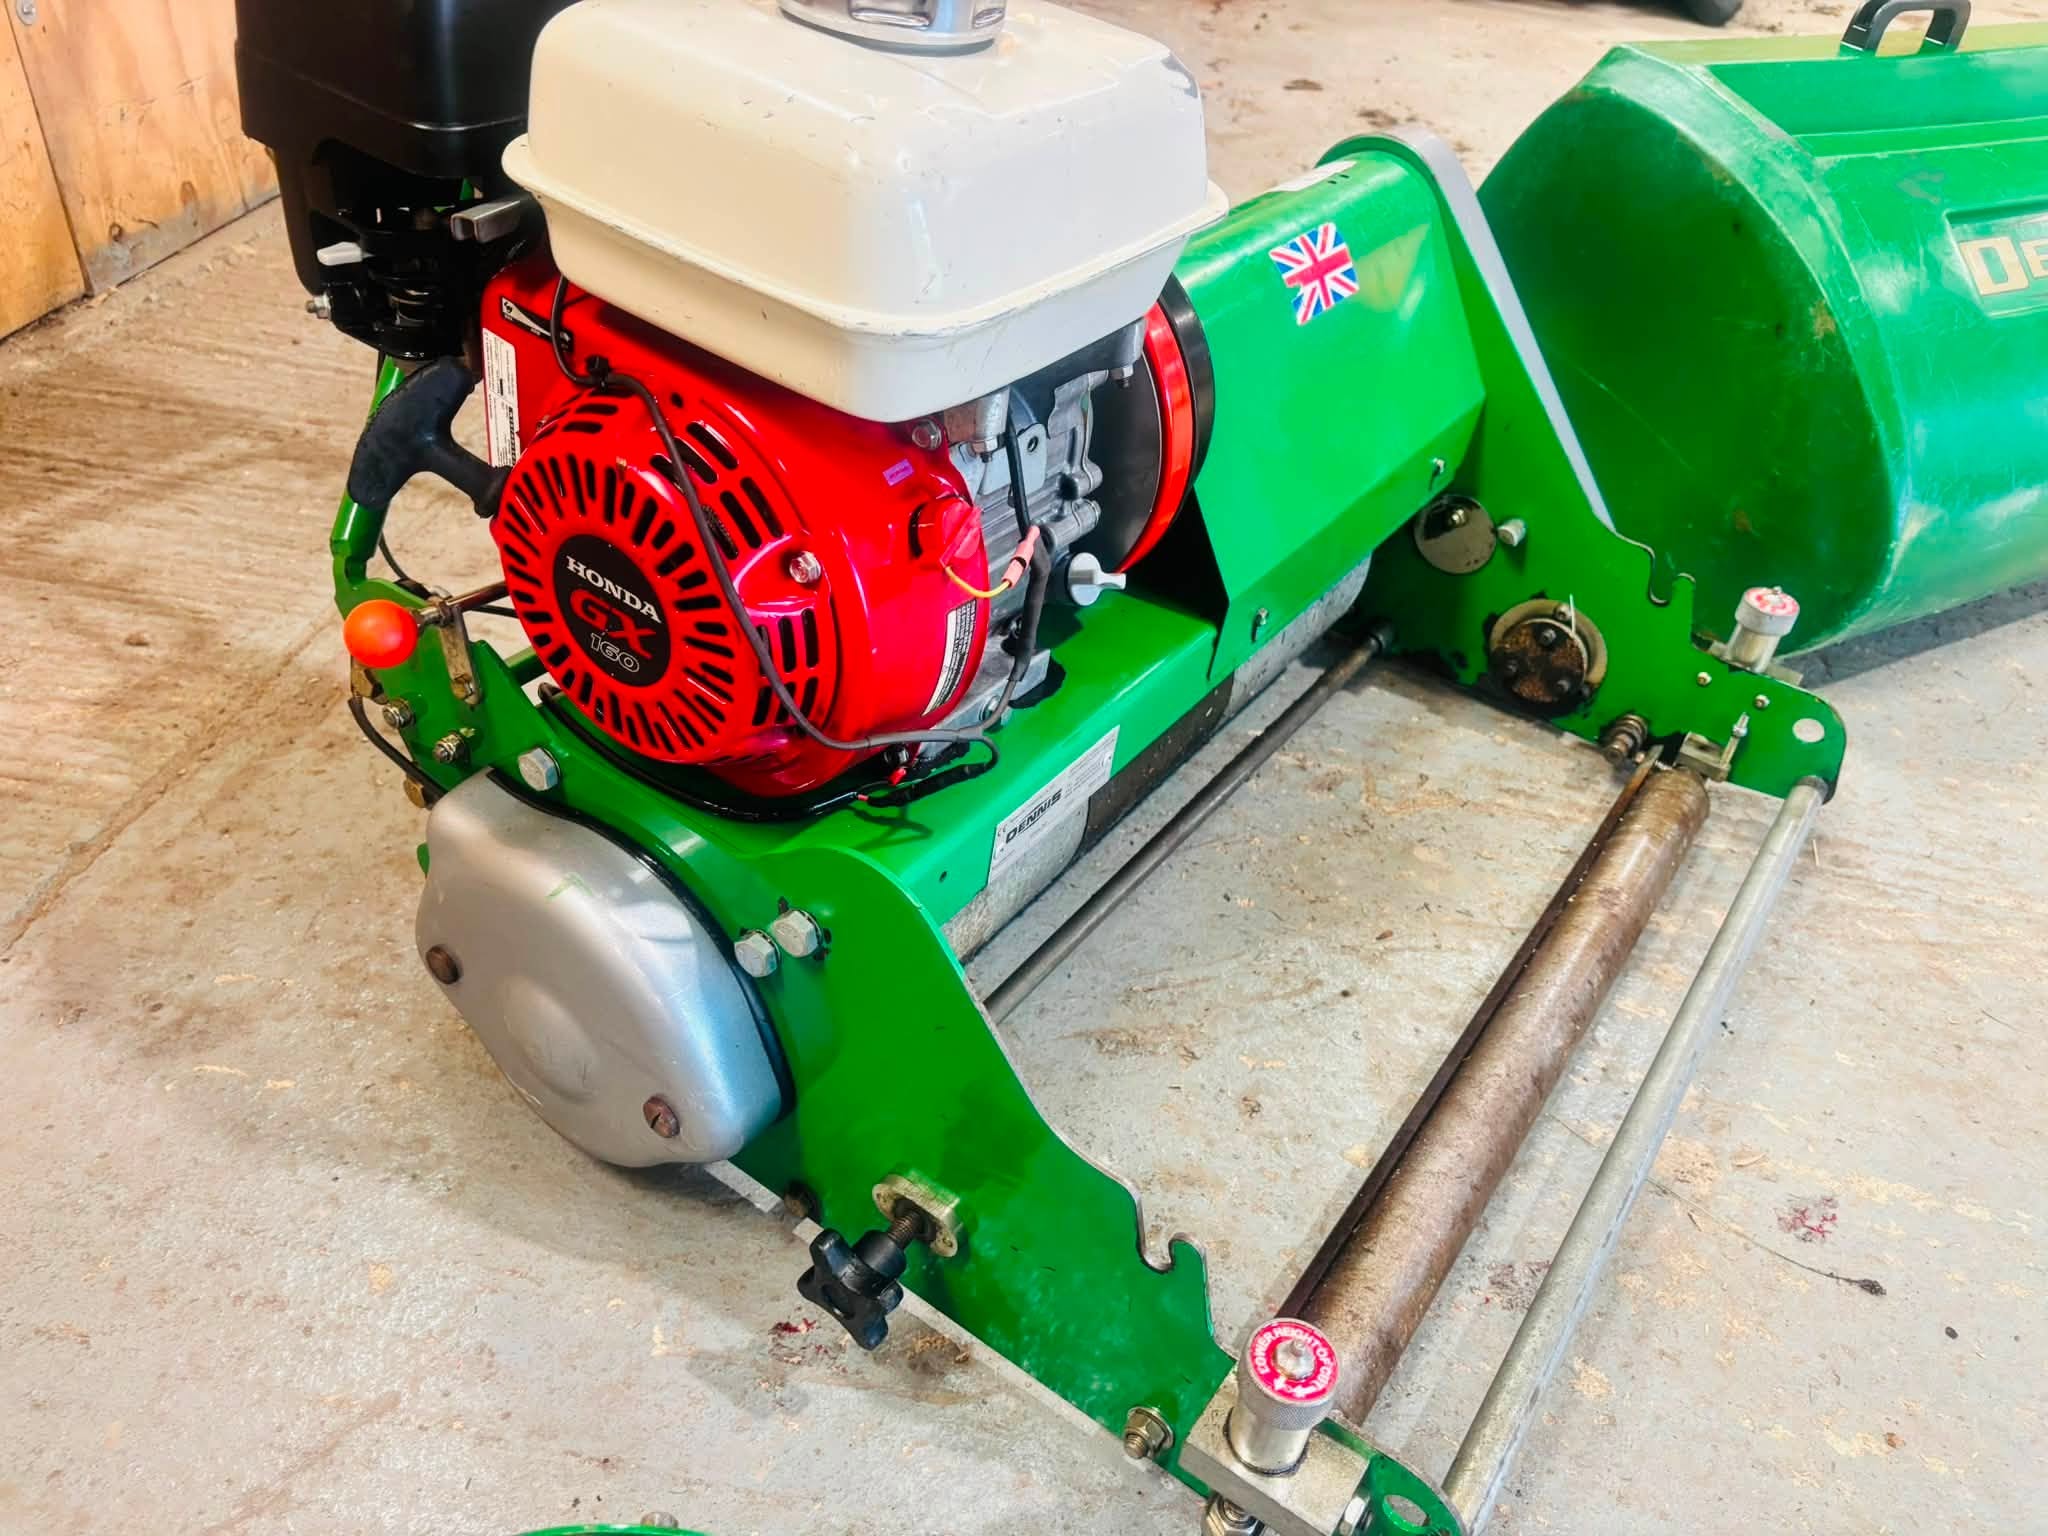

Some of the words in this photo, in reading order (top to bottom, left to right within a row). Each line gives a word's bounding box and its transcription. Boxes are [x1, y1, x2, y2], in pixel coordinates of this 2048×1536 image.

[566, 555, 662, 624] HONDA
[570, 588, 657, 659] GX
[590, 632, 640, 673] 160
[1005, 788, 1063, 844] DENNIS
[1254, 1332, 1272, 1374] LOWER
[1315, 1347, 1333, 1365] OF
